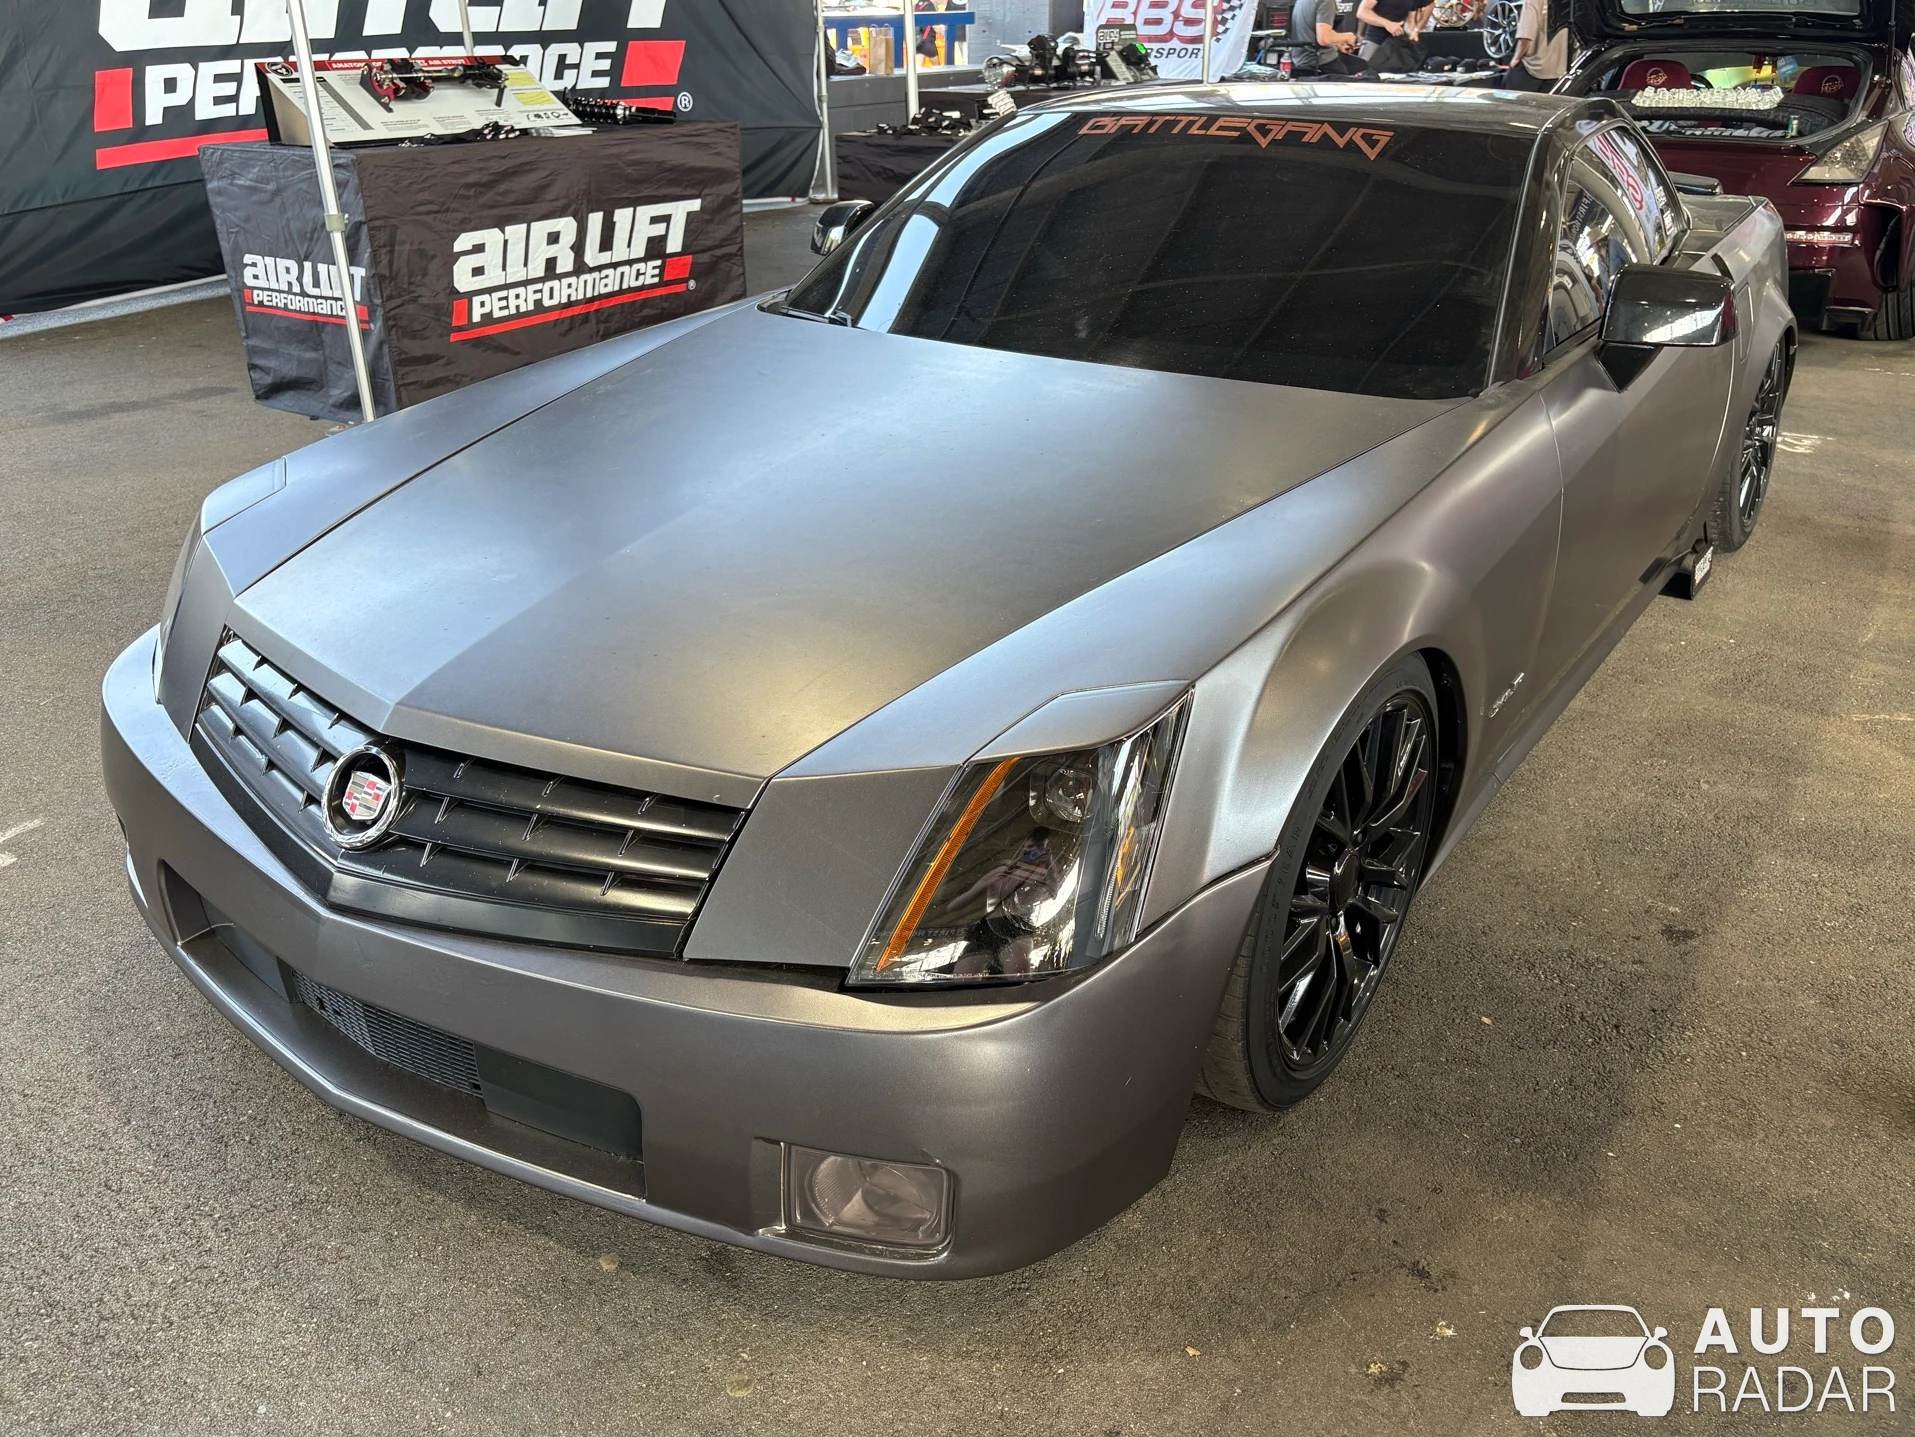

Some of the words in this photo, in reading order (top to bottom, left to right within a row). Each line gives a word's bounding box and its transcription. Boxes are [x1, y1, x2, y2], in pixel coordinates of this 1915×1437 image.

[1097, 0, 1222, 43] BBS
[1077, 115, 1395, 161] BATTLEGANG
[584, 198, 702, 268] LIFT
[252, 289, 347, 316] PERFORMANC
[471, 259, 662, 323] PERFORMANCE
